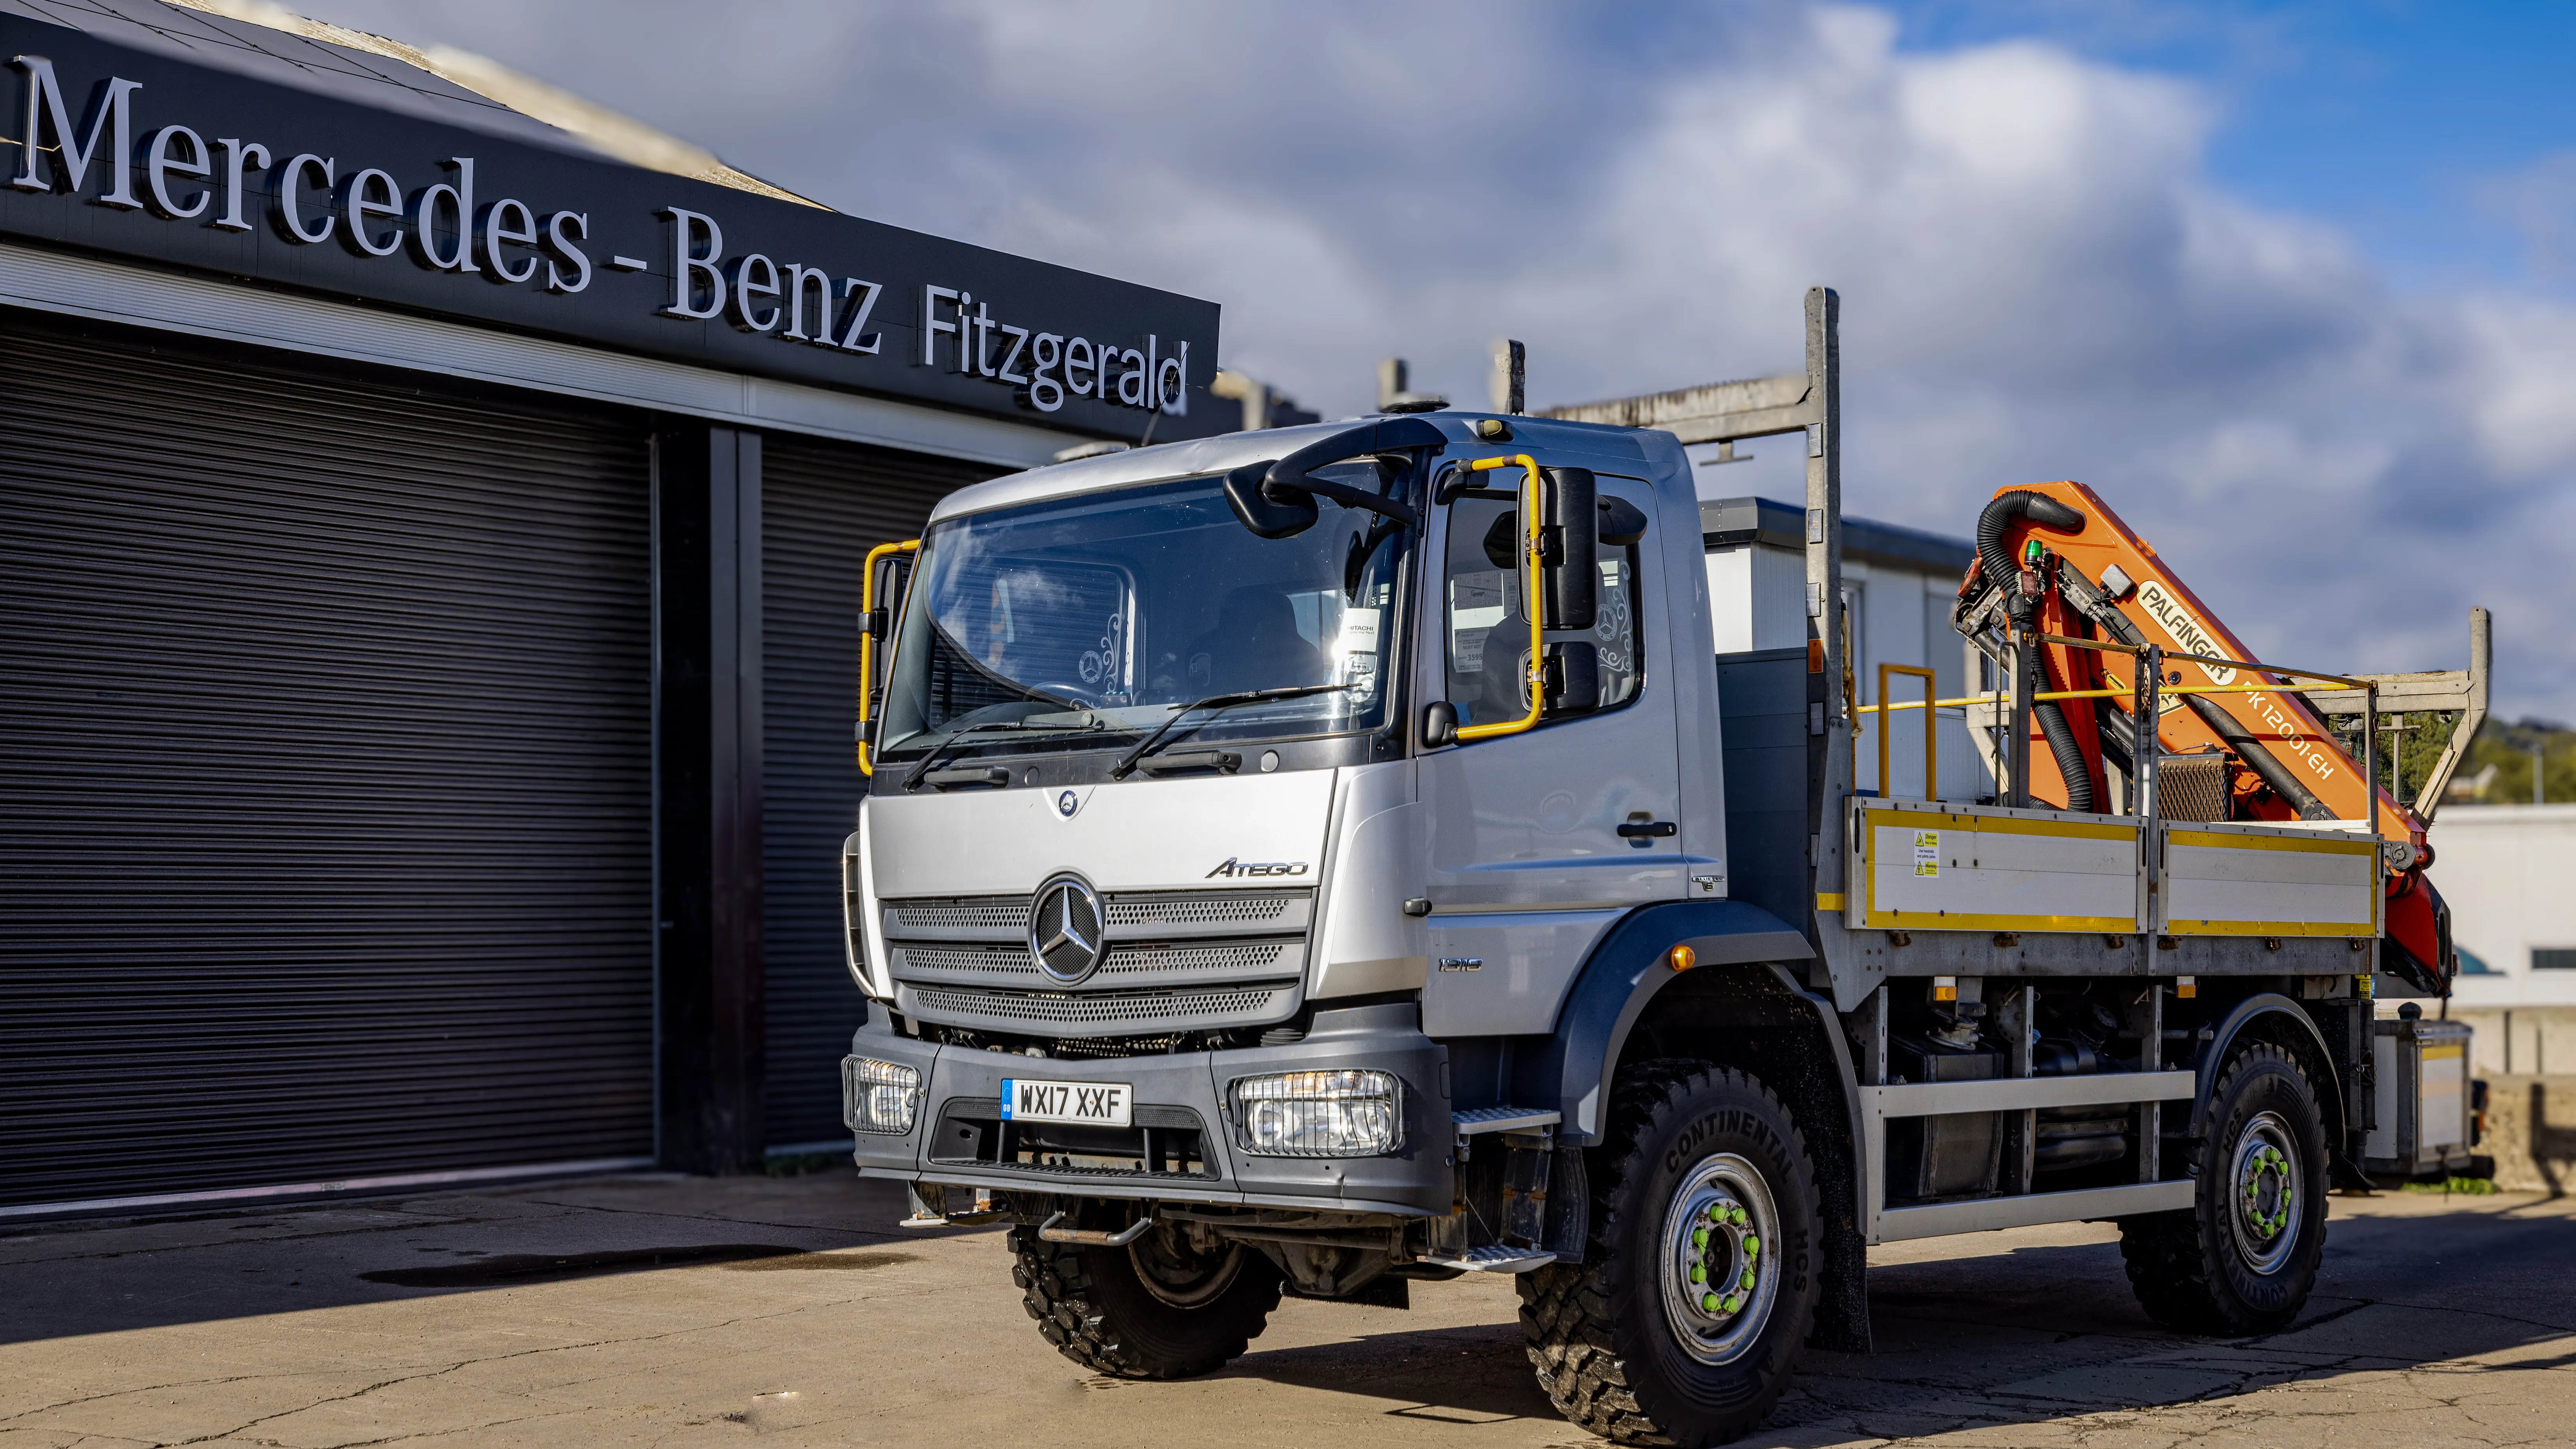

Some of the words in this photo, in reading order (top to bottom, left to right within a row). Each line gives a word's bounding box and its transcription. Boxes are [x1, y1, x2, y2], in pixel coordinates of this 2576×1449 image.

[925, 284, 1187, 412] Fitzgerald
[1598, 605, 1613, 614] ERCEDES
[2142, 586, 2230, 680] PALFINGER
[1205, 857, 1308, 878] ATEGO
[1439, 959, 1482, 972] 1318
[1003, 1104, 1011, 1112] GB
[1021, 1085, 1069, 1115] WX17
[1076, 1088, 1121, 1118] XXF
[1666, 1110, 1793, 1185] CONTINENTAL
[1793, 1228, 1809, 1292] HCS
